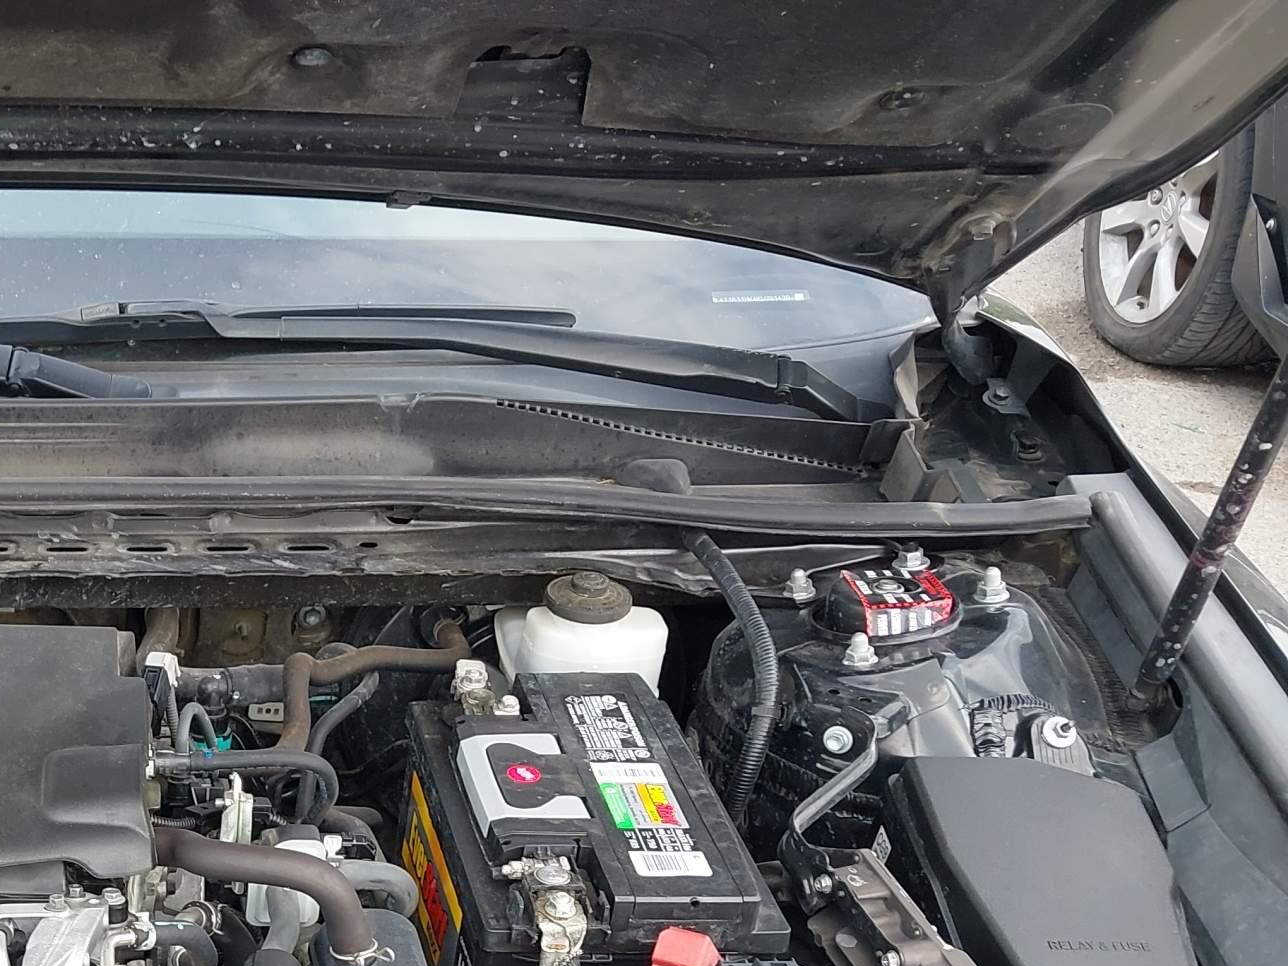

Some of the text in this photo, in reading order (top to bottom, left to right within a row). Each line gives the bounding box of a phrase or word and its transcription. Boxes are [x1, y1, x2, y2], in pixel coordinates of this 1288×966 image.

[1047, 940, 1153, 952] RELAY & FUSE
